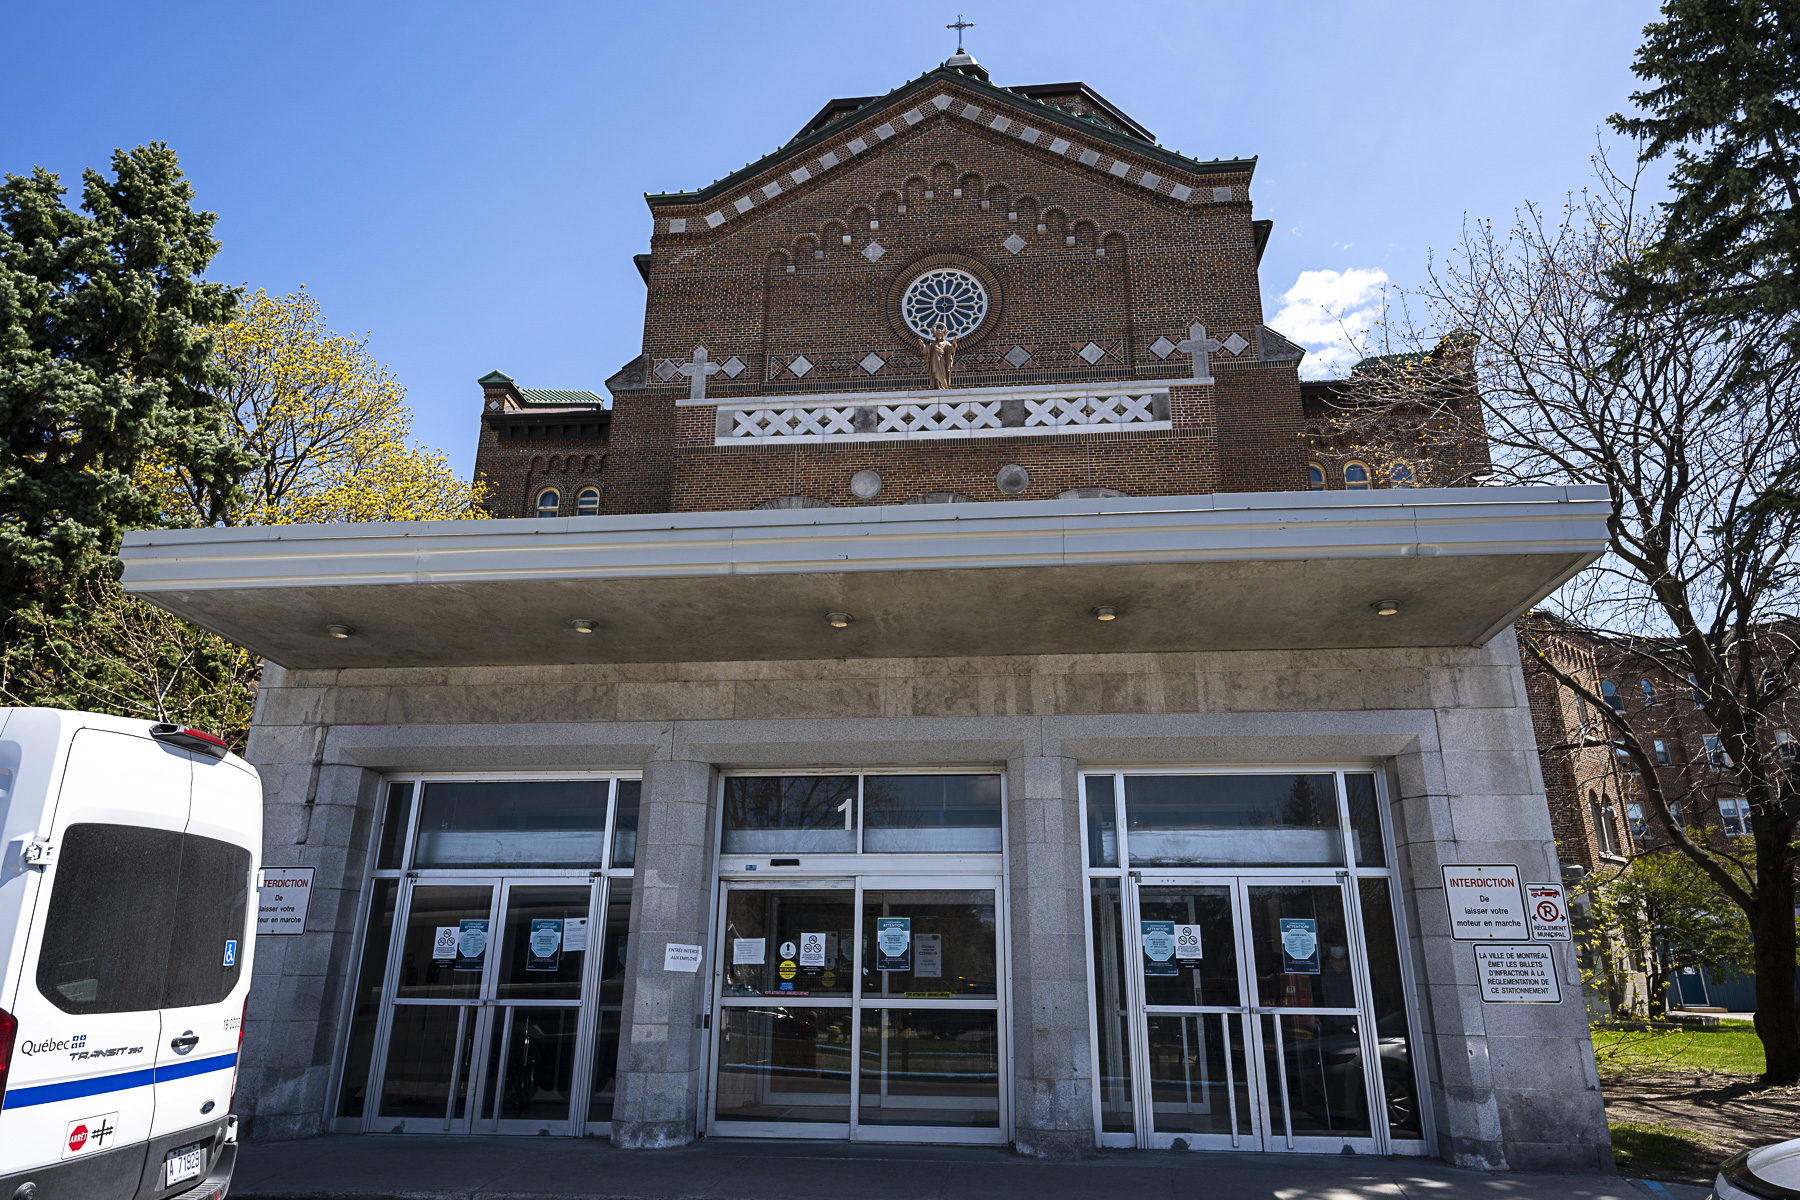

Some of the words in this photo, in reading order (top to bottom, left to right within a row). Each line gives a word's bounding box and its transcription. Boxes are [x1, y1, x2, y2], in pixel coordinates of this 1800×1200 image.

[838, 798, 852, 831] 1
[263, 879, 309, 888] TERDICTION
[1449, 878, 1515, 888] INTERDICTION
[1517, 951, 1549, 959] MONTRÉAL
[1488, 960, 1504, 968] ÉMET
[21, 1038, 70, 1056] Québec
[69, 1046, 128, 1061] TRANSIT
[70, 1132, 87, 1143] ARRÊT
[169, 1160, 174, 1176] A
